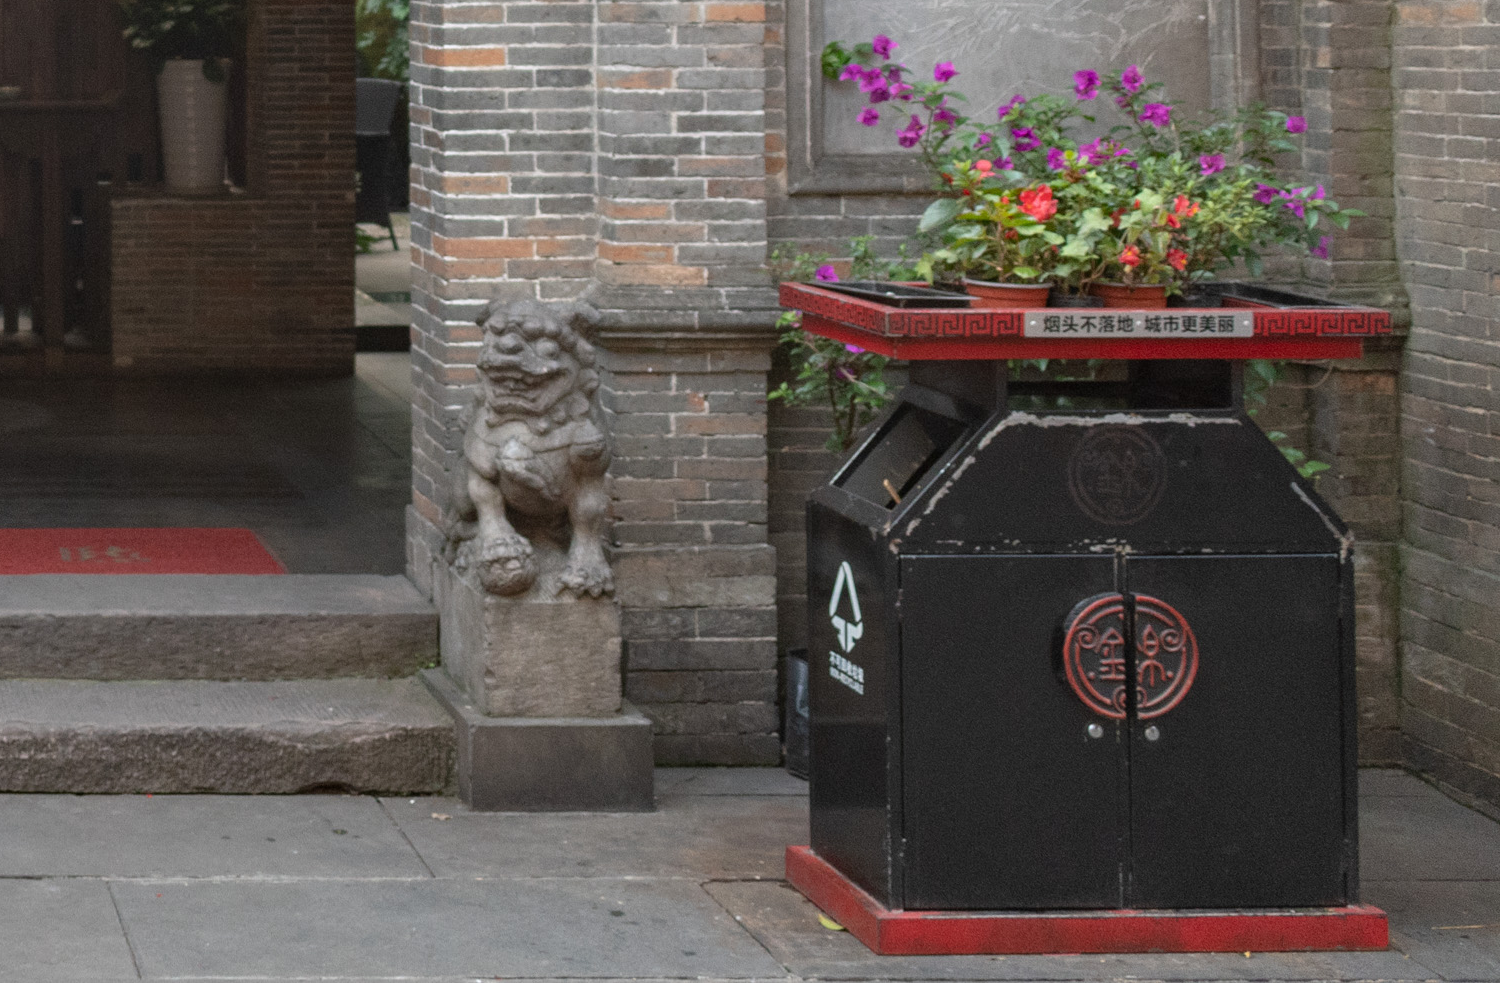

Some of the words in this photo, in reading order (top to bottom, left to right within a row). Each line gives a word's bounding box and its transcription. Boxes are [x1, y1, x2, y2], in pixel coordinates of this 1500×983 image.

[1043, 314, 1134, 333] 烟头不落地
[1144, 314, 1235, 333] 城市更美丽
